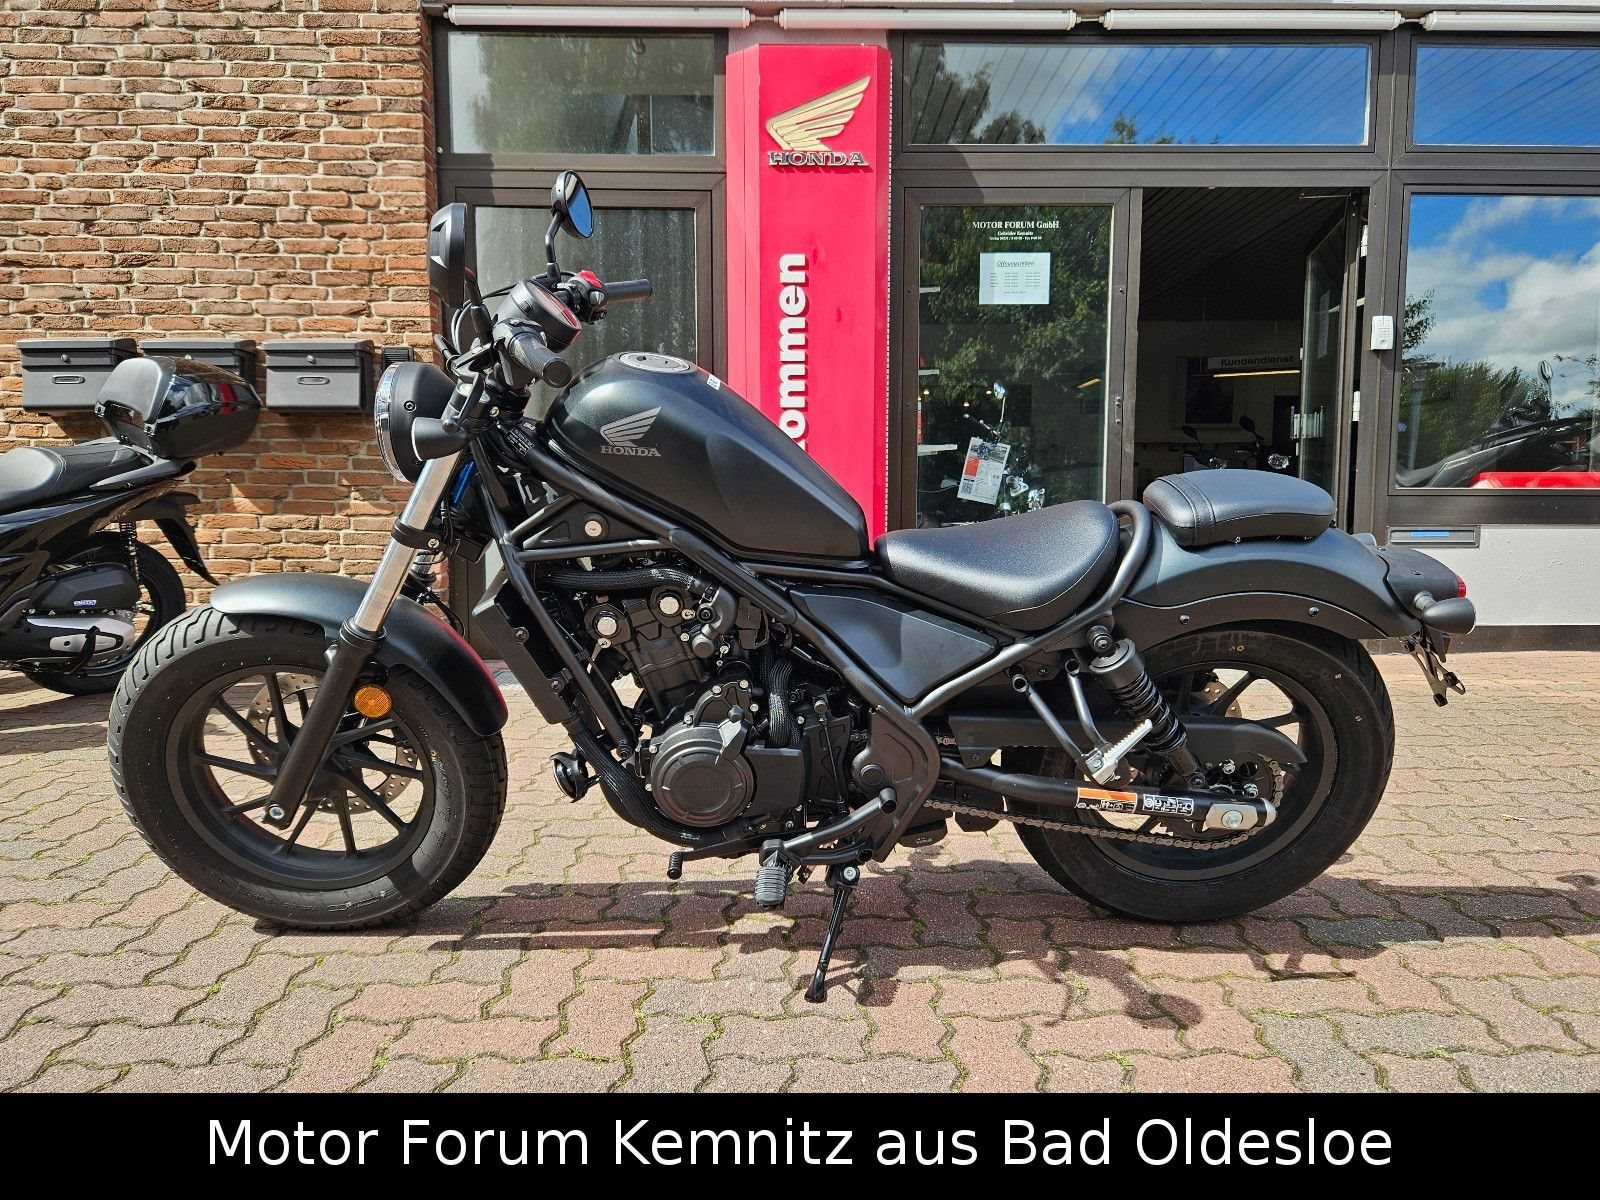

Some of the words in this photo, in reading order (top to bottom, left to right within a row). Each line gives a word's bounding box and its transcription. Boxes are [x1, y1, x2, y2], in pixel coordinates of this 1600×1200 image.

[767, 151, 869, 166] HONDA
[972, 221, 1003, 229] MOTOR
[1004, 221, 1035, 229] FORUM
[1036, 220, 1060, 229] GmbH
[778, 253, 806, 450] ommen
[1220, 355, 1293, 367] Kundendienst
[600, 445, 661, 457] HONDA
